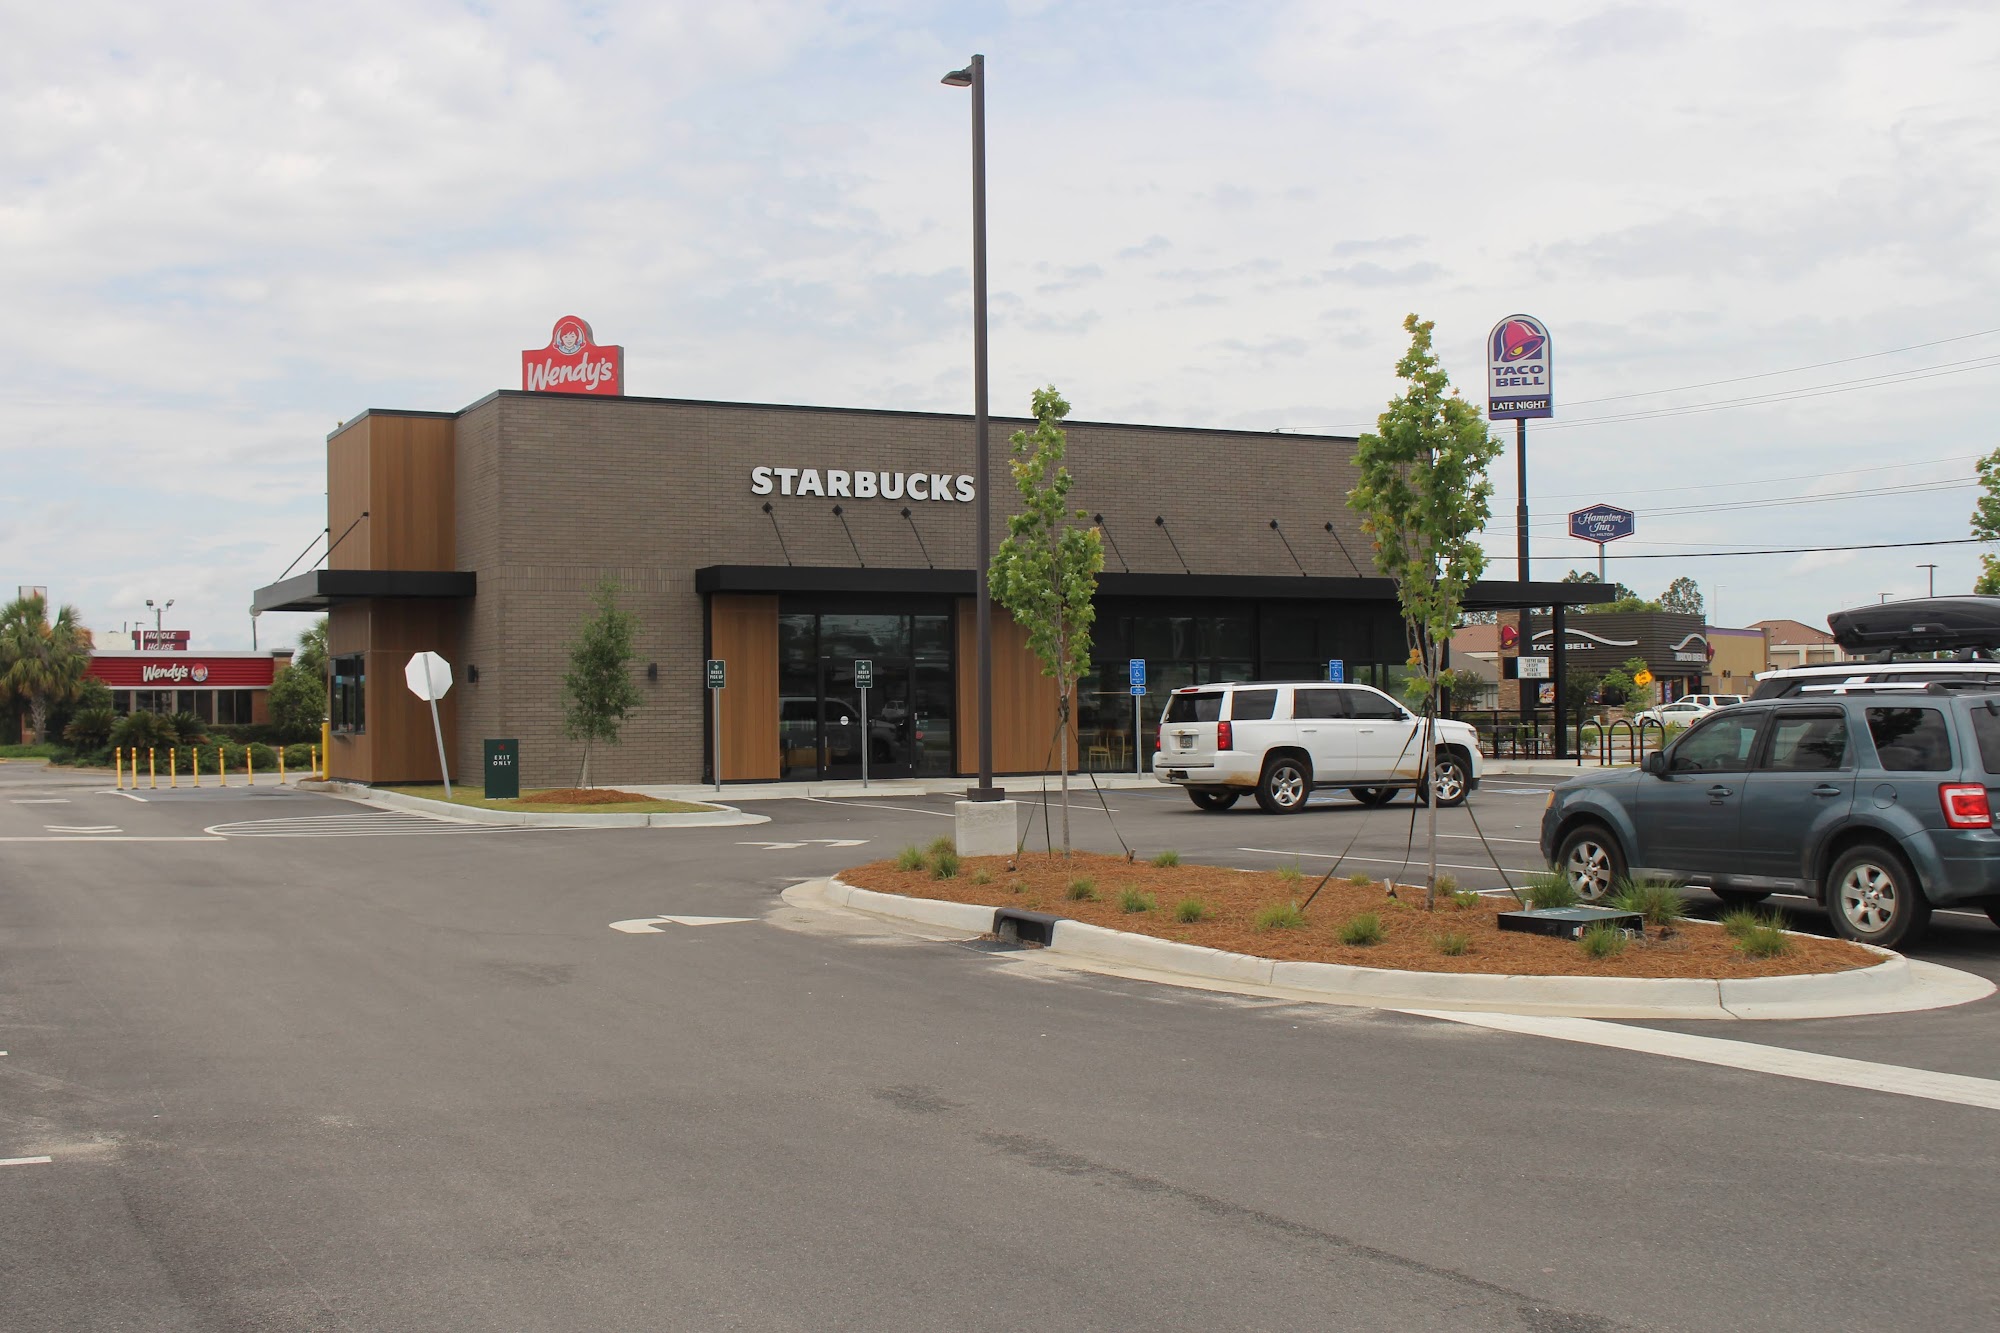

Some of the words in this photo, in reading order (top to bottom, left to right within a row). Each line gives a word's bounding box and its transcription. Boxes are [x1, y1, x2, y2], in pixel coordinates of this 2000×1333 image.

[528, 352, 613, 391] Wendy's
[1492, 365, 1544, 376] TACO
[1496, 376, 1545, 387] BELL
[1492, 402, 1514, 411] LATE
[1516, 400, 1546, 410] NIGHT
[751, 466, 976, 502] STARBUCKS
[1578, 512, 1626, 525] Hampton
[1589, 522, 1614, 533] Inn
[1532, 643, 1554, 651] TAC
[1564, 642, 1596, 650] BELL
[143, 663, 188, 682] Wendy's
